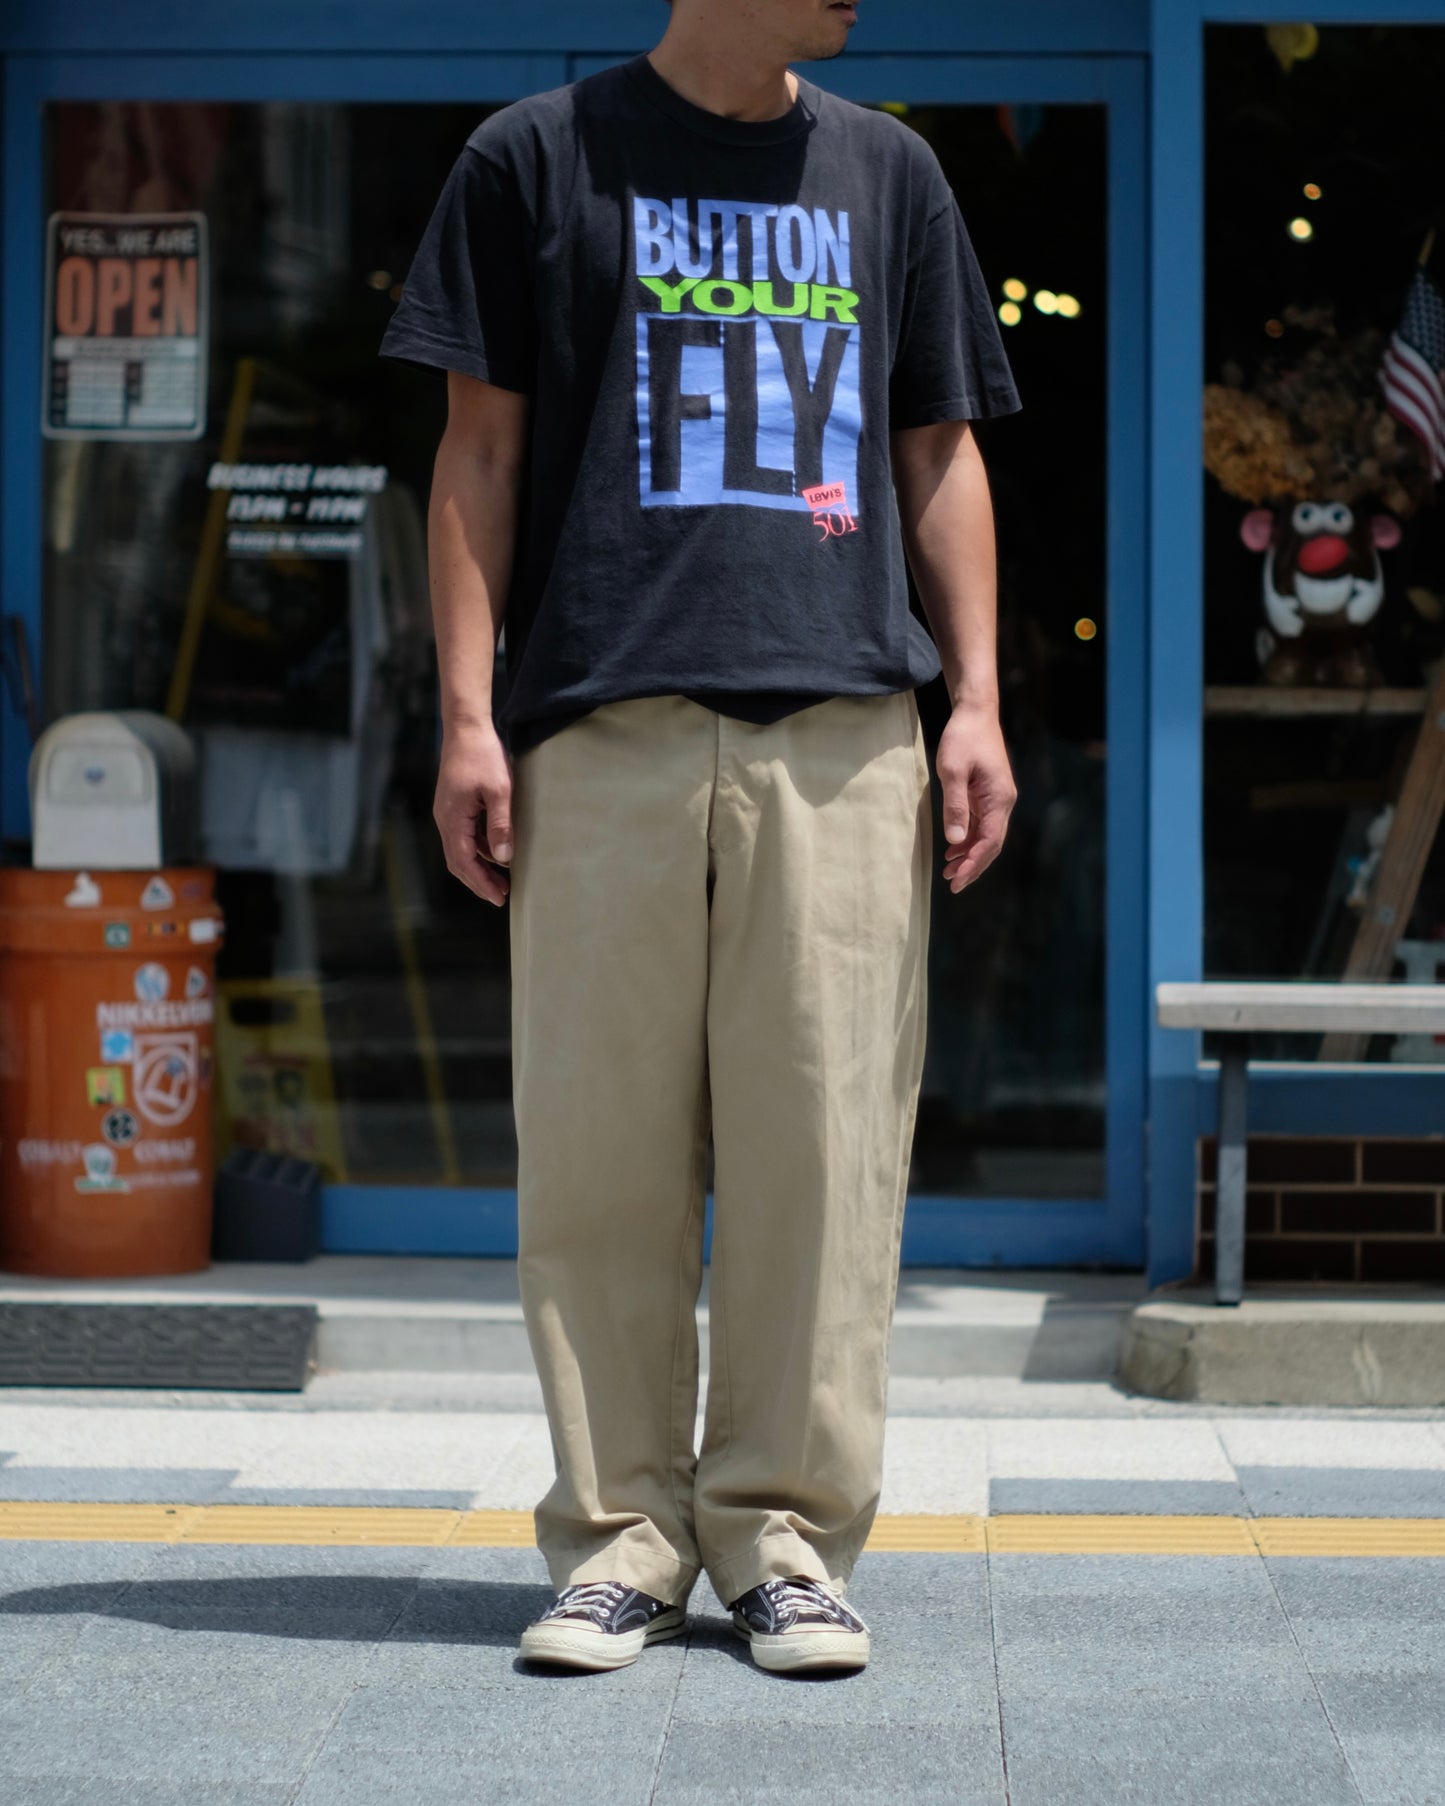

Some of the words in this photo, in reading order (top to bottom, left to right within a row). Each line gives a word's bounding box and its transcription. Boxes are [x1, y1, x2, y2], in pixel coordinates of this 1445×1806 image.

[153, 227, 196, 252] ARE
[633, 196, 853, 288] BUTTON
[57, 256, 198, 337] OPEN
[638, 277, 860, 324] YOUR
[647, 317, 853, 502] FLY
[812, 503, 859, 543] 501
